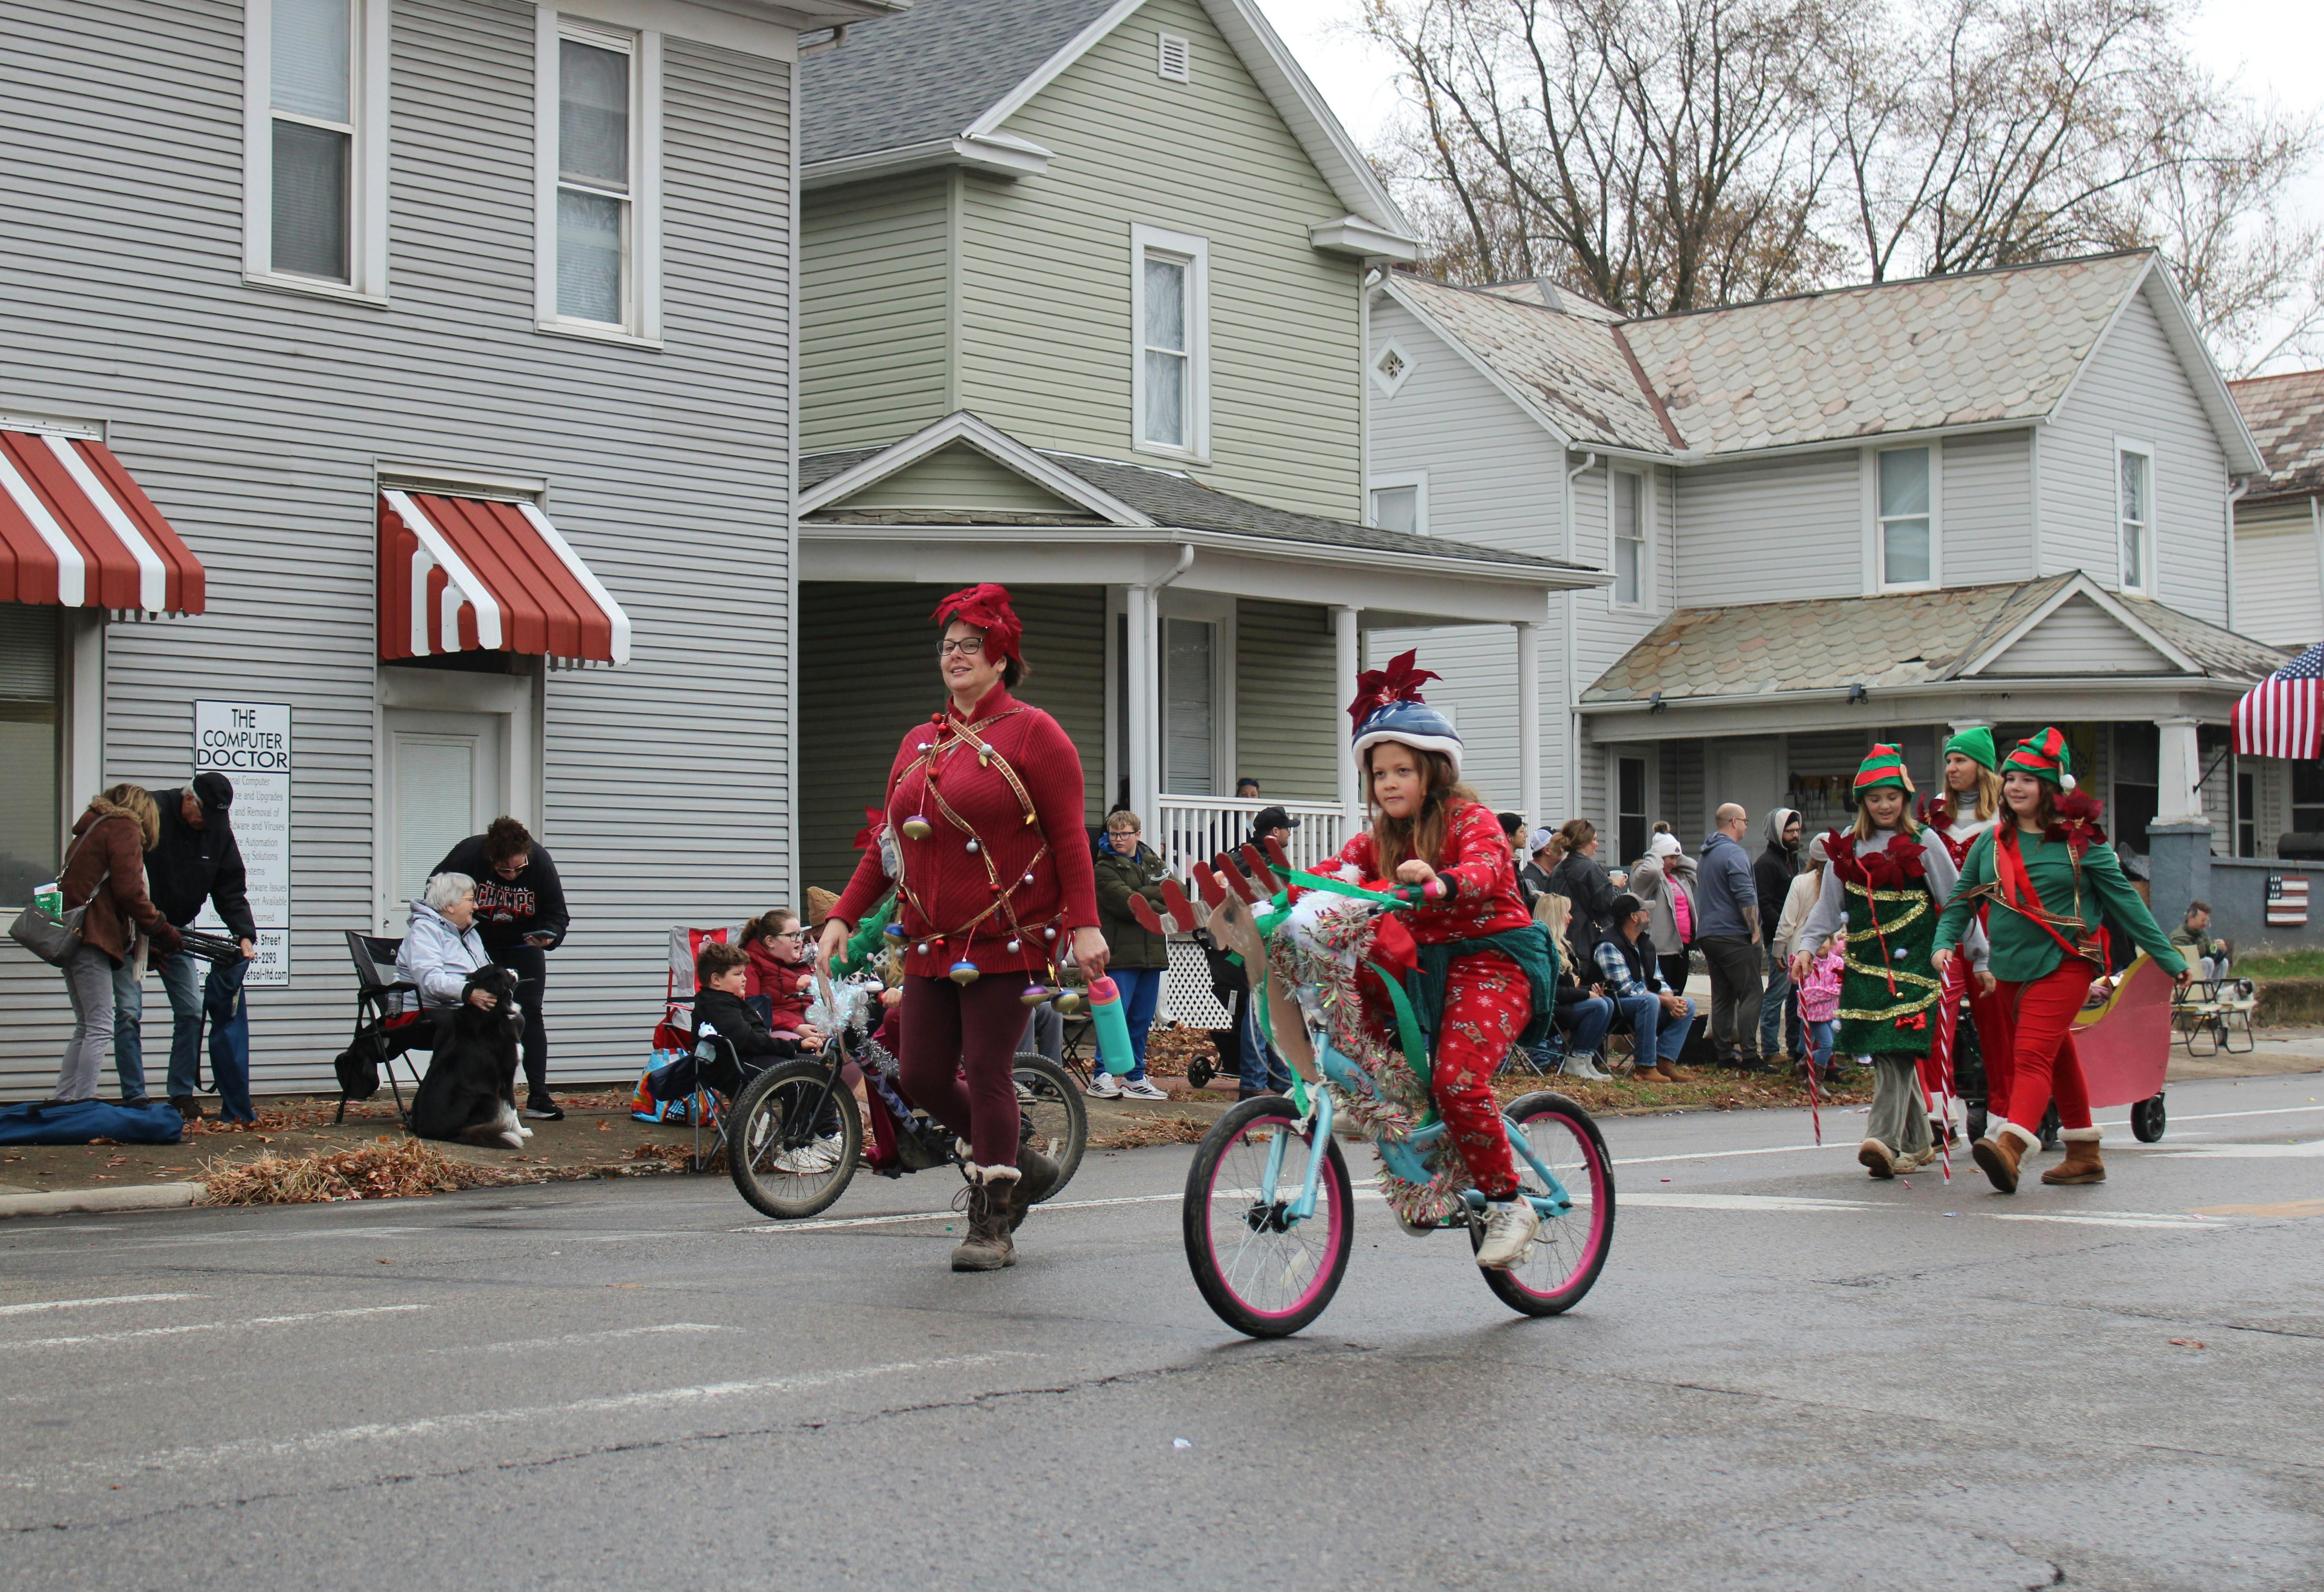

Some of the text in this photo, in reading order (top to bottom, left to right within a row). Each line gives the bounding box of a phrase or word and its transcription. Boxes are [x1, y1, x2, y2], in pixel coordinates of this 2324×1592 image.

[232, 709, 255, 728] THE
[204, 730, 282, 749] COMPUTER
[197, 749, 288, 768] DOCTOR
[242, 775, 270, 787] Computer
[244, 791, 255, 800] and
[256, 791, 283, 803] Upgrades
[247, 807, 271, 816] Removal
[273, 807, 280, 817] of
[251, 820, 262, 830] and
[264, 821, 285, 831] Viruses
[245, 837, 278, 847] Automation
[252, 850, 278, 860] Solutions
[246, 867, 265, 876] ystems
[247, 882, 287, 892] oftware Issues
[262, 896, 287, 906] Available
[476, 883, 535, 915] CHAMPS
[210, 912, 221, 921] Hou
[261, 934, 280, 946] Street
[251, 952, 276, 963] 3-2293
[244, 968, 287, 980] etsol-ltd.com
[666, 1113, 686, 1121] ALDI
